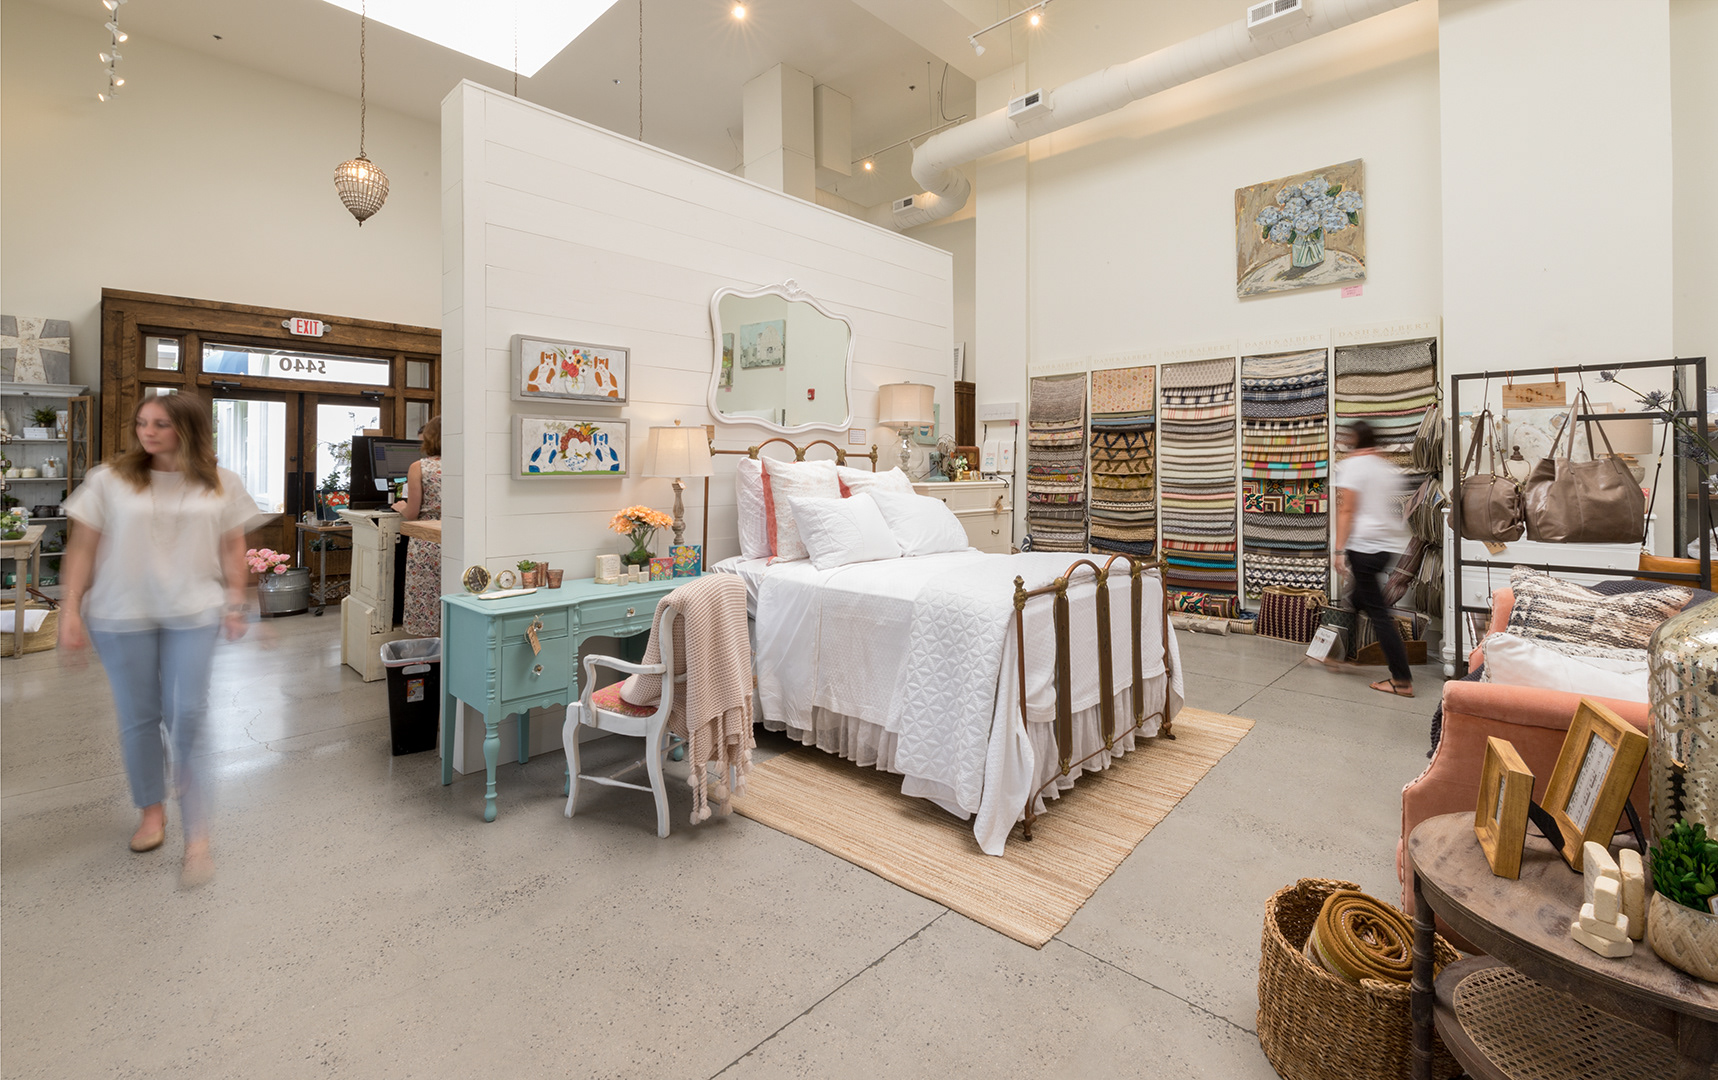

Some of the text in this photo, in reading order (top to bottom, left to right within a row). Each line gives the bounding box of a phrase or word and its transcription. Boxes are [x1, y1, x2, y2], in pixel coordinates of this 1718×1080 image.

[297, 319, 319, 335] EXIT
[1338, 329, 1369, 337] DASH
[1382, 322, 1430, 333] ALBERT
[1244, 339, 1271, 348] DASH
[1282, 334, 1323, 344] ALBERT
[1164, 348, 1187, 357] DASH
[1197, 344, 1231, 353] ALBERT
[1093, 356, 1114, 364] DASH
[1123, 353, 1152, 361] ALBERT
